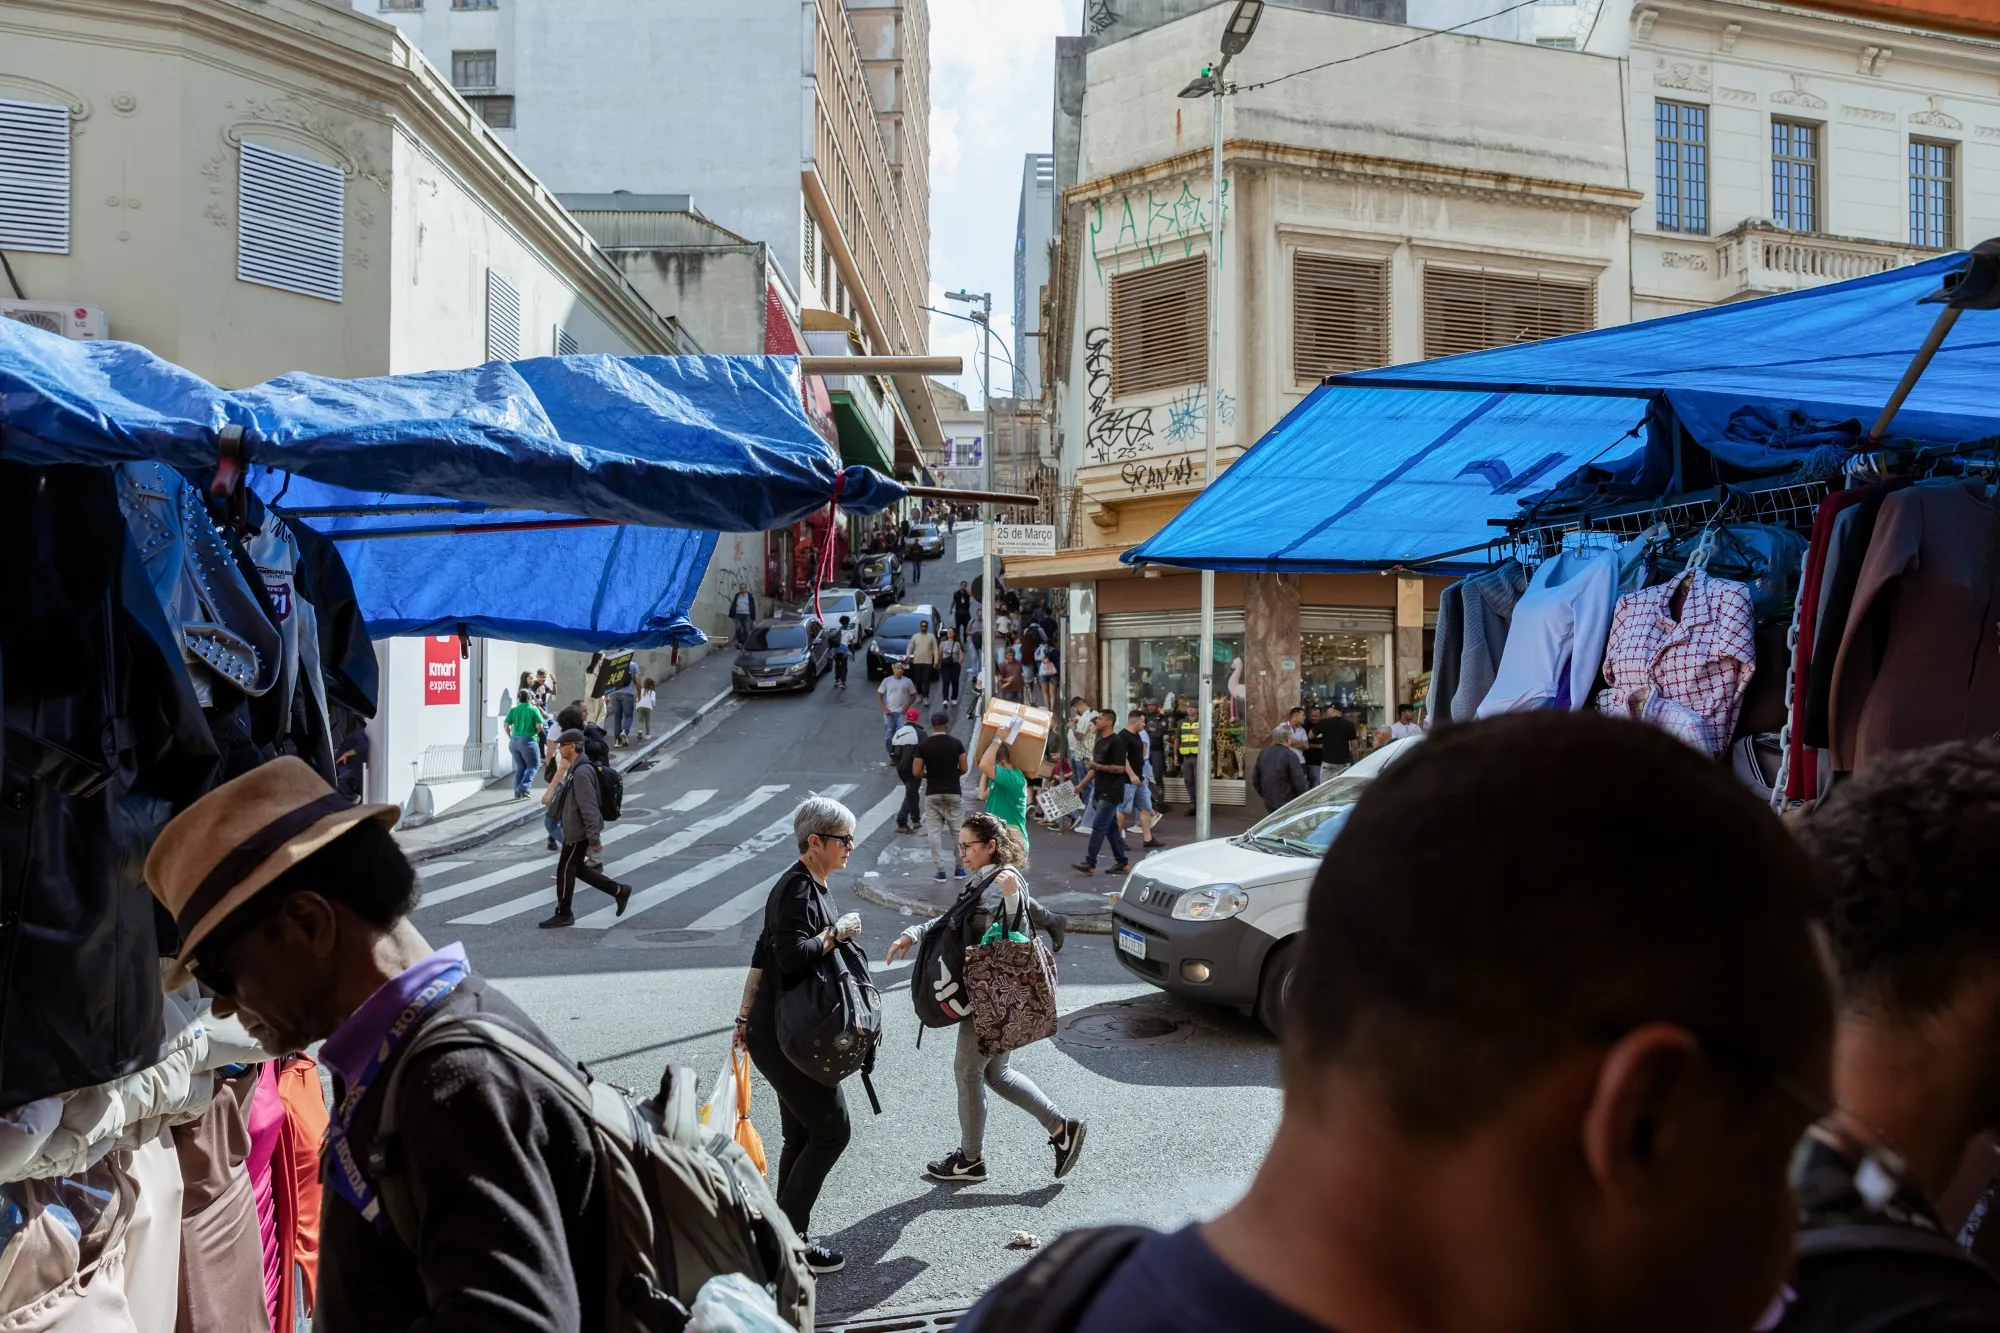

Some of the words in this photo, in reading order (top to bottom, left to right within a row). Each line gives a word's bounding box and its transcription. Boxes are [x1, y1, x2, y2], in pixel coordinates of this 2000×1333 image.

[997, 528, 1009, 539] 25
[1012, 528, 1022, 539] de
[1025, 528, 1053, 542] Março
[429, 680, 457, 694] express
[391, 979, 450, 1038] HONDA
[335, 1136, 368, 1199] HONDA
